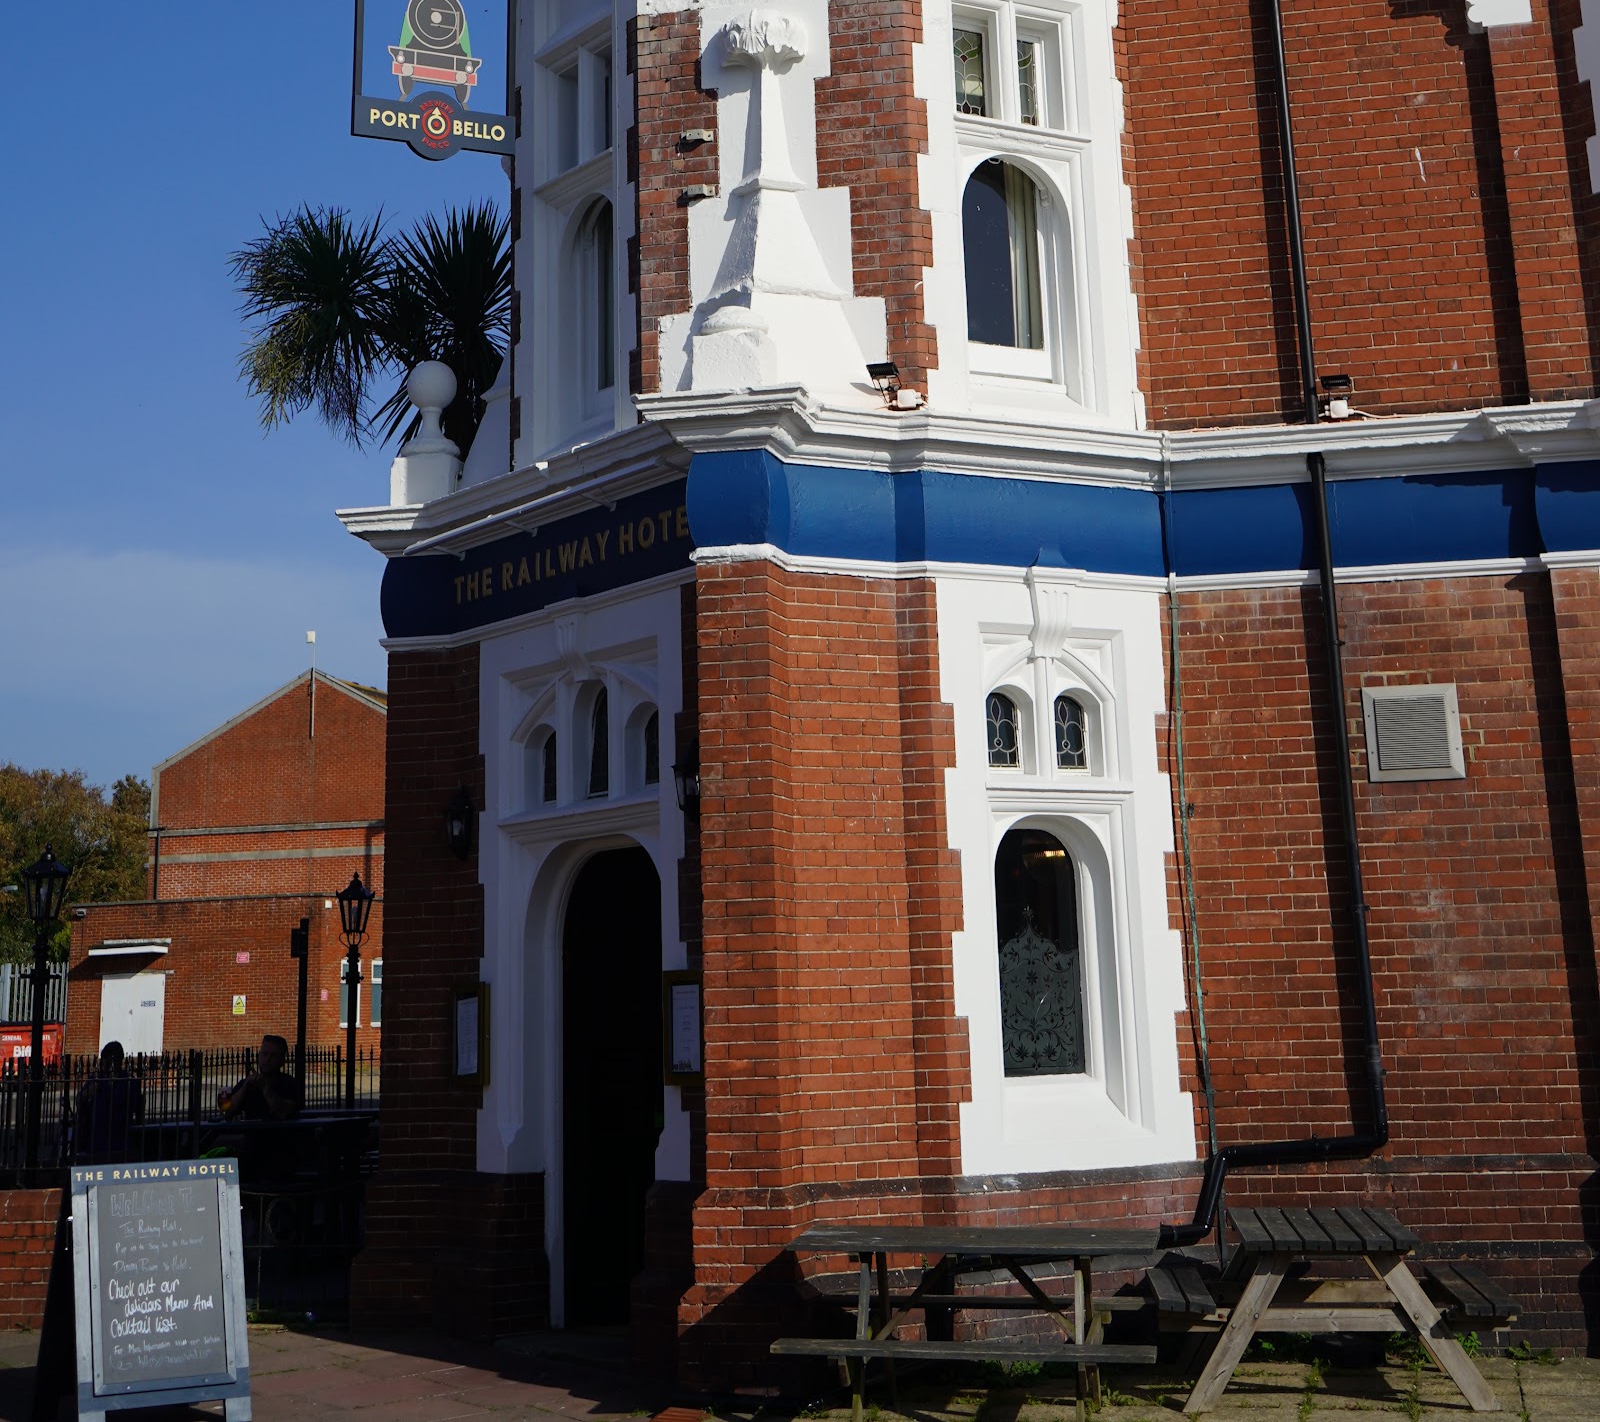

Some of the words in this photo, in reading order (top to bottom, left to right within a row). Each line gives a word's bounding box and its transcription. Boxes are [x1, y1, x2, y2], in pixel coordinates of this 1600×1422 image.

[454, 567, 492, 604] THE
[502, 529, 611, 592] RAILWAY
[618, 505, 689, 555] HOTE
[75, 1172, 104, 1181] THE
[113, 1166, 180, 1180] RAILWAY
[189, 1164, 235, 1175] HOTEL
[109, 1278, 135, 1300] Check
[137, 1276, 156, 1297] out
[160, 1278, 180, 1293] our
[124, 1297, 162, 1318] delicious
[165, 1294, 189, 1312] Menu
[110, 1315, 151, 1338] Cocktail
